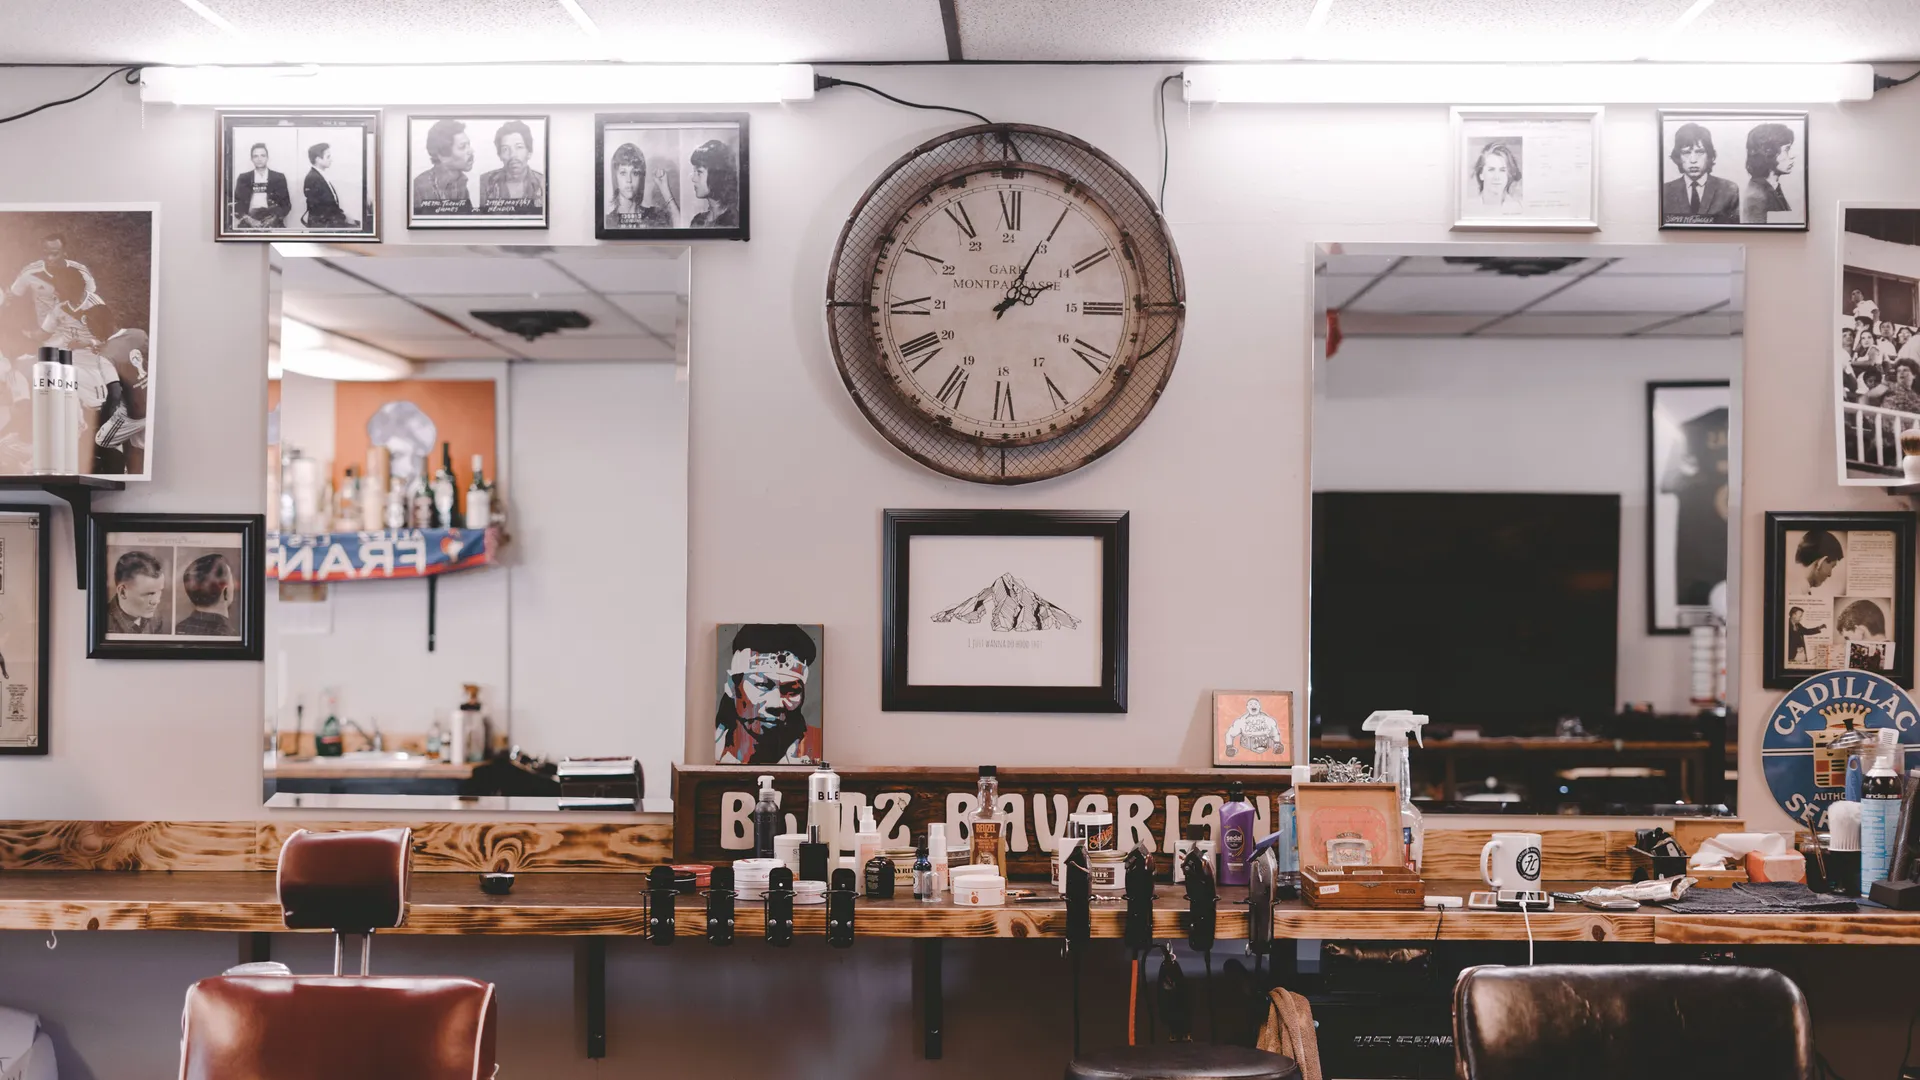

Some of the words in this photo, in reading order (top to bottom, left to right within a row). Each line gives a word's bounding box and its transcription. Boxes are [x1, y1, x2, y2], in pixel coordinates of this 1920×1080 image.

[1002, 232, 1016, 244] 24
[968, 241, 983, 252] 23
[941, 265, 956, 276] 22
[1058, 268, 1071, 279] 14
[934, 299, 947, 310] 21
[1065, 303, 1078, 314] 15
[941, 330, 955, 341] 20
[1057, 333, 1070, 344] 16
[963, 355, 976, 366] 19
[1032, 357, 1046, 368] 17
[997, 367, 1010, 377] 18
[1774, 677, 1918, 736] CADILLAC
[721, 791, 911, 851] BTZ
[976, 823, 996, 833] REUZEL
[1227, 834, 1242, 842] sedal
